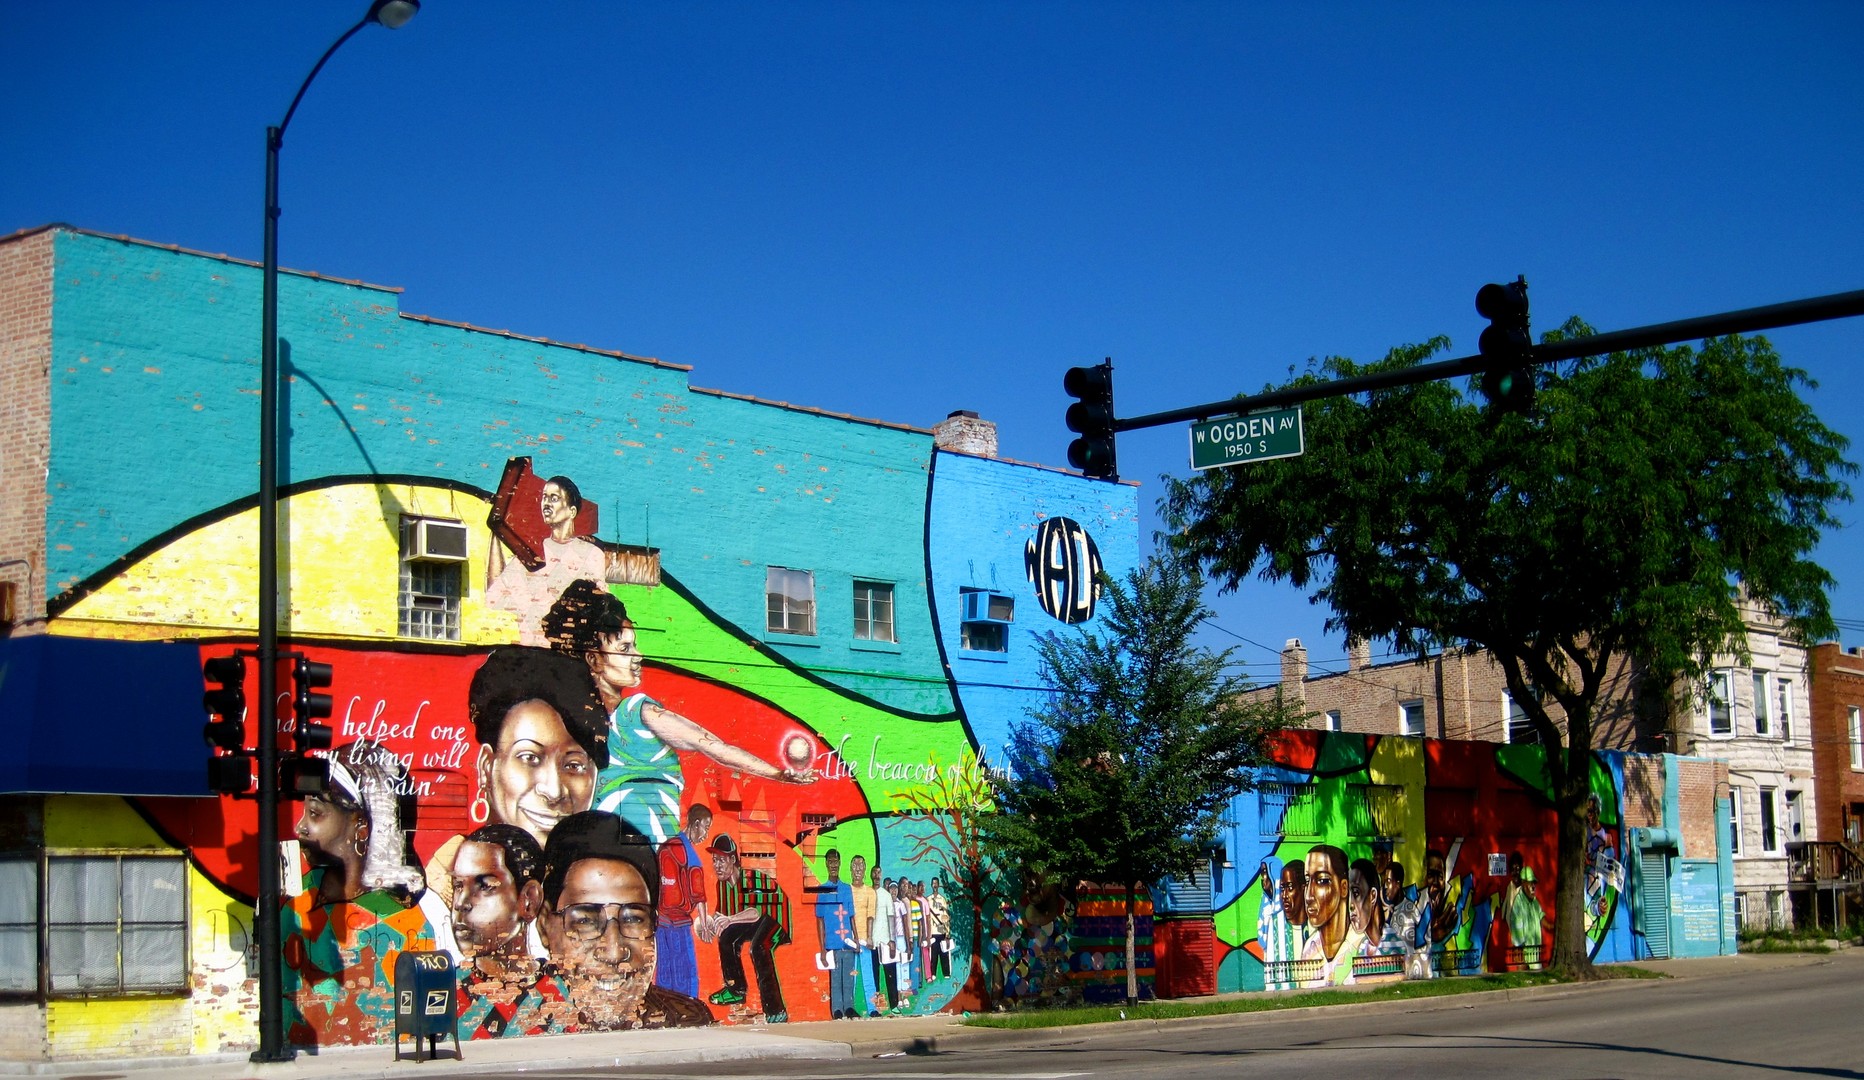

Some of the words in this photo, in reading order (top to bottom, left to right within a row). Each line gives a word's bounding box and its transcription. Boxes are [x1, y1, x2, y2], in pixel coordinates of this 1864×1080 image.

[1196, 431, 1205, 443] W
[1210, 417, 1275, 443] OGDEN
[1280, 416, 1295, 431] AV
[1224, 442, 1252, 458] 1950
[1259, 440, 1267, 453] S
[342, 695, 430, 749] helped
[431, 725, 467, 740] one
[349, 736, 414, 781] living
[422, 741, 470, 769] will
[817, 733, 861, 780] The
[868, 735, 937, 784] beacon
[943, 738, 970, 810] of
[355, 773, 377, 795] in
